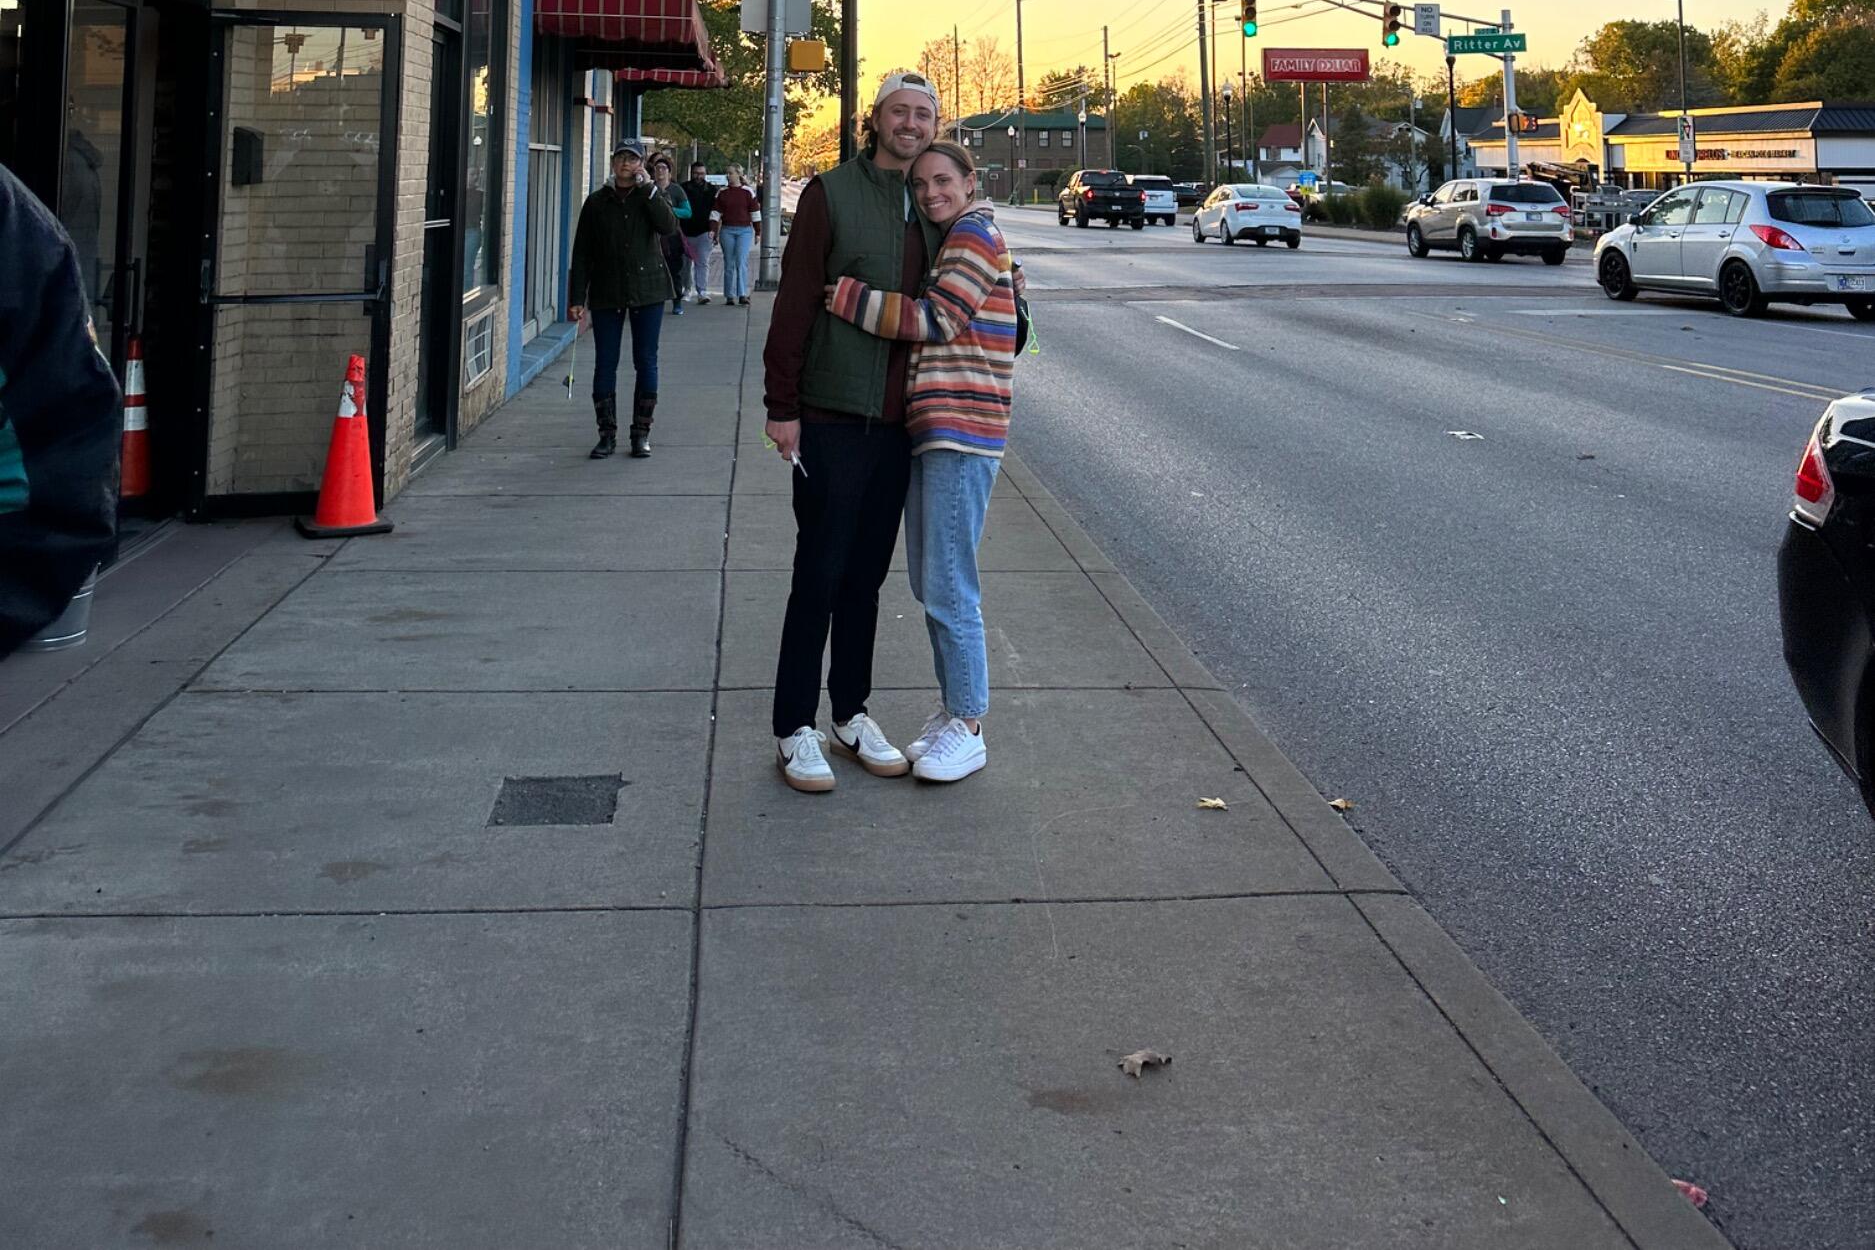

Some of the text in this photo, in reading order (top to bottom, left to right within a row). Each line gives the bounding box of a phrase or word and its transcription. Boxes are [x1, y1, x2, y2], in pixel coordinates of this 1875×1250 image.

[1420, 6, 1433, 14] NO
[1454, 39, 1521, 51] Ritter Av
[1271, 58, 1361, 72] FAMILY DOLLAR
